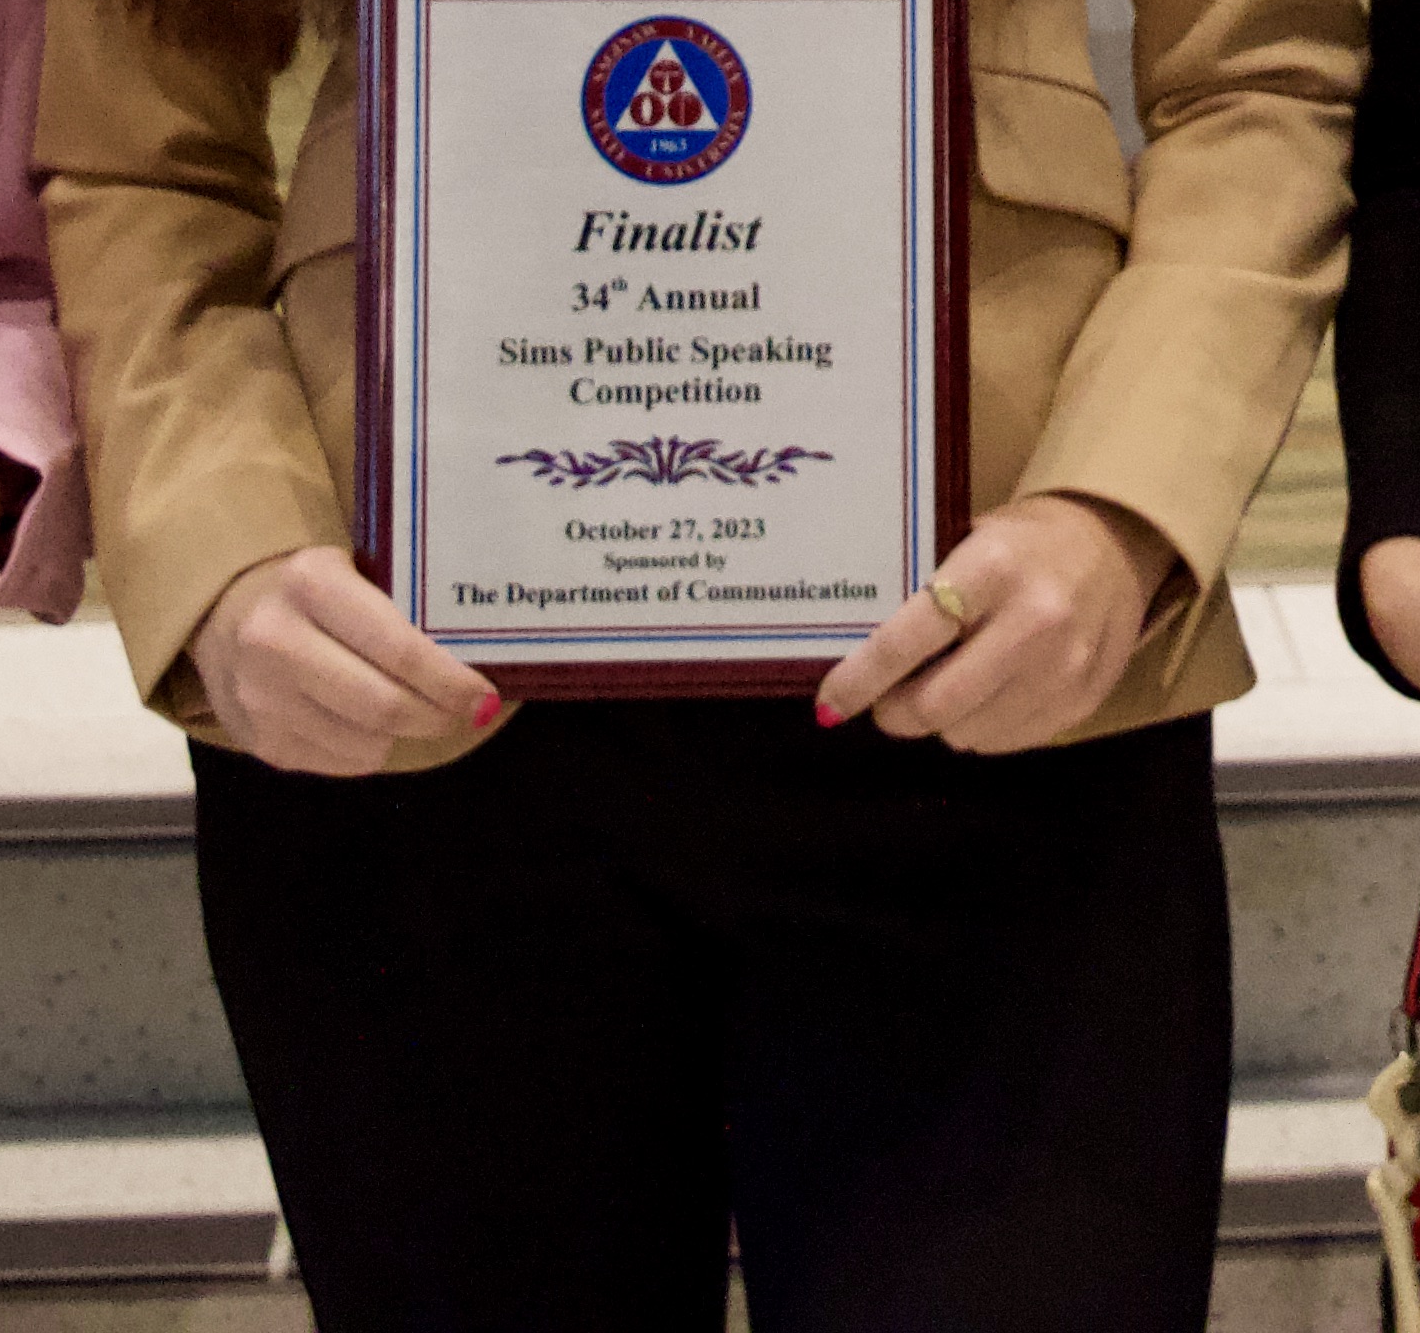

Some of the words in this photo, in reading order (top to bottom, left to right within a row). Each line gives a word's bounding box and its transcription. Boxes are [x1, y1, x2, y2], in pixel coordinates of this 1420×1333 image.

[574, 210, 762, 253] Finalist
[572, 277, 628, 312] 34th
[638, 282, 760, 312] Annual
[499, 338, 573, 366] Sims
[584, 337, 680, 365] Public
[690, 336, 833, 371] Speaking
[568, 377, 762, 412] Competition
[564, 520, 662, 542] October
[669, 518, 704, 542] 27,
[711, 517, 766, 540] 2023
[603, 552, 700, 574] Sponsored
[704, 551, 727, 572] by
[456, 583, 498, 606] The
[506, 582, 649, 610] Department
[656, 580, 681, 602] of
[685, 580, 878, 602] Communication
